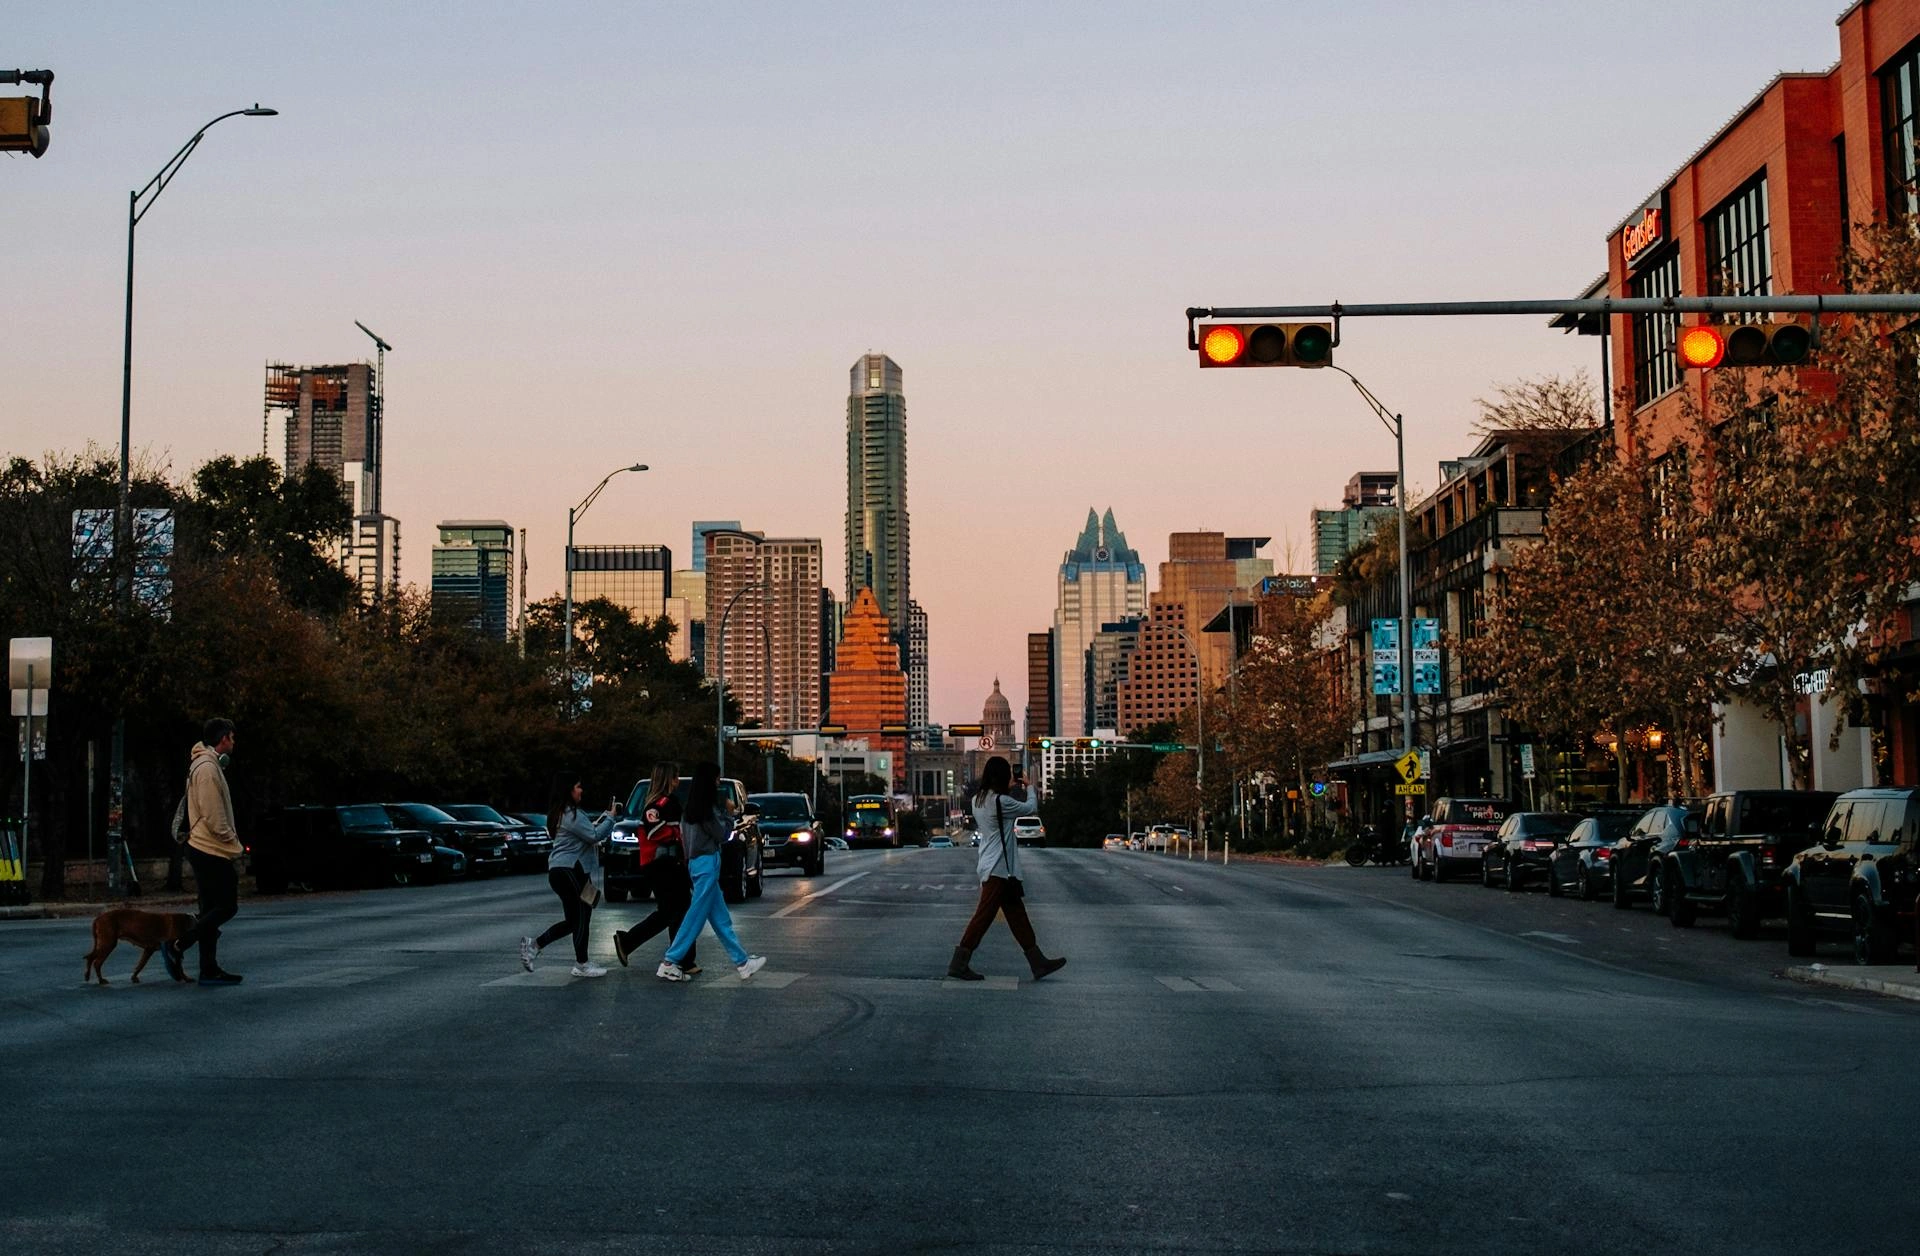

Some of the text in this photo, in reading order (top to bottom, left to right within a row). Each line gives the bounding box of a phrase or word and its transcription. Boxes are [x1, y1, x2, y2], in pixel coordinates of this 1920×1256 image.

[1623, 208, 1657, 262] Gensler
[1464, 804, 1487, 812] Texas
[1494, 811, 1504, 819] DJ
